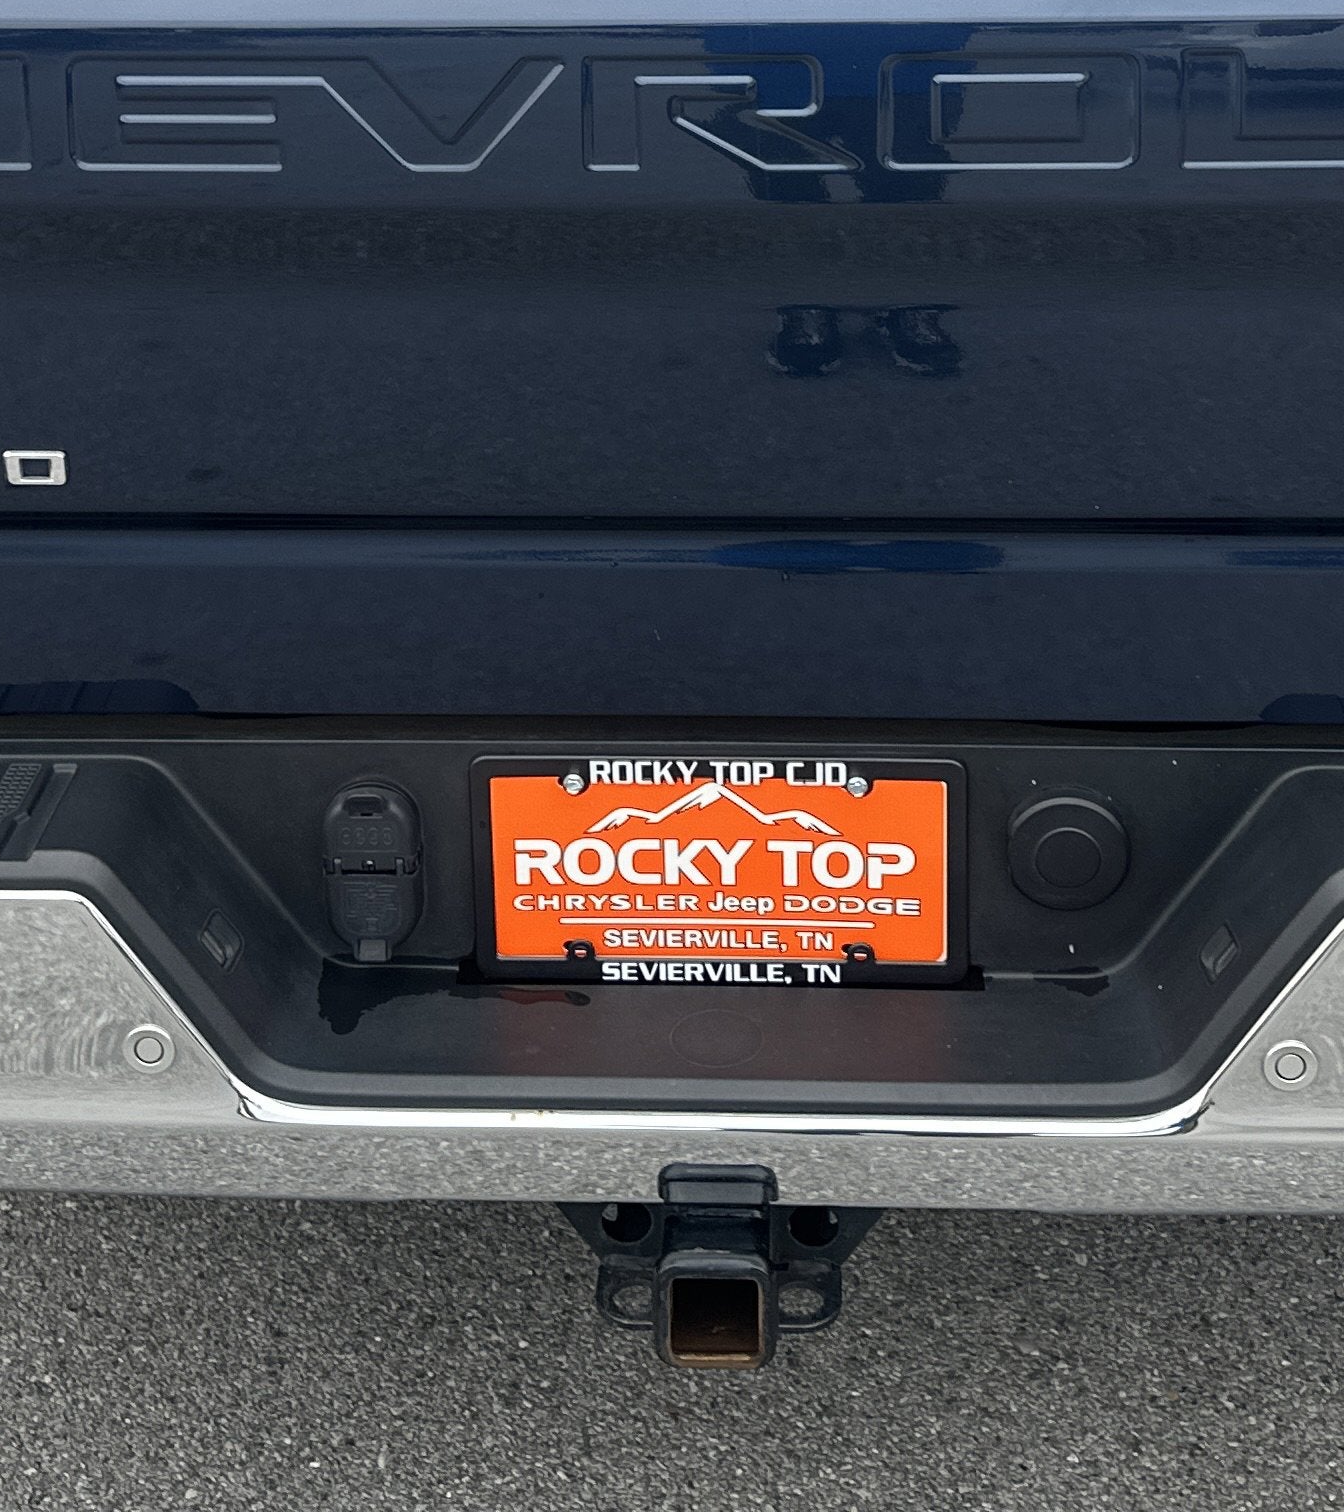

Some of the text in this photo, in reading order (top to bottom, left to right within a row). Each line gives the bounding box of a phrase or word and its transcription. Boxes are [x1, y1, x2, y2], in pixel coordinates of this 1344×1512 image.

[588, 759, 848, 787] ROCKY TOP CJD
[513, 837, 917, 890] ROCKY TOP
[512, 891, 921, 916] CHRYSLER Jeep DODGE
[602, 929, 834, 952] SEVIERVILLE, TN
[600, 962, 841, 984] SEVIERVILLE, TN
